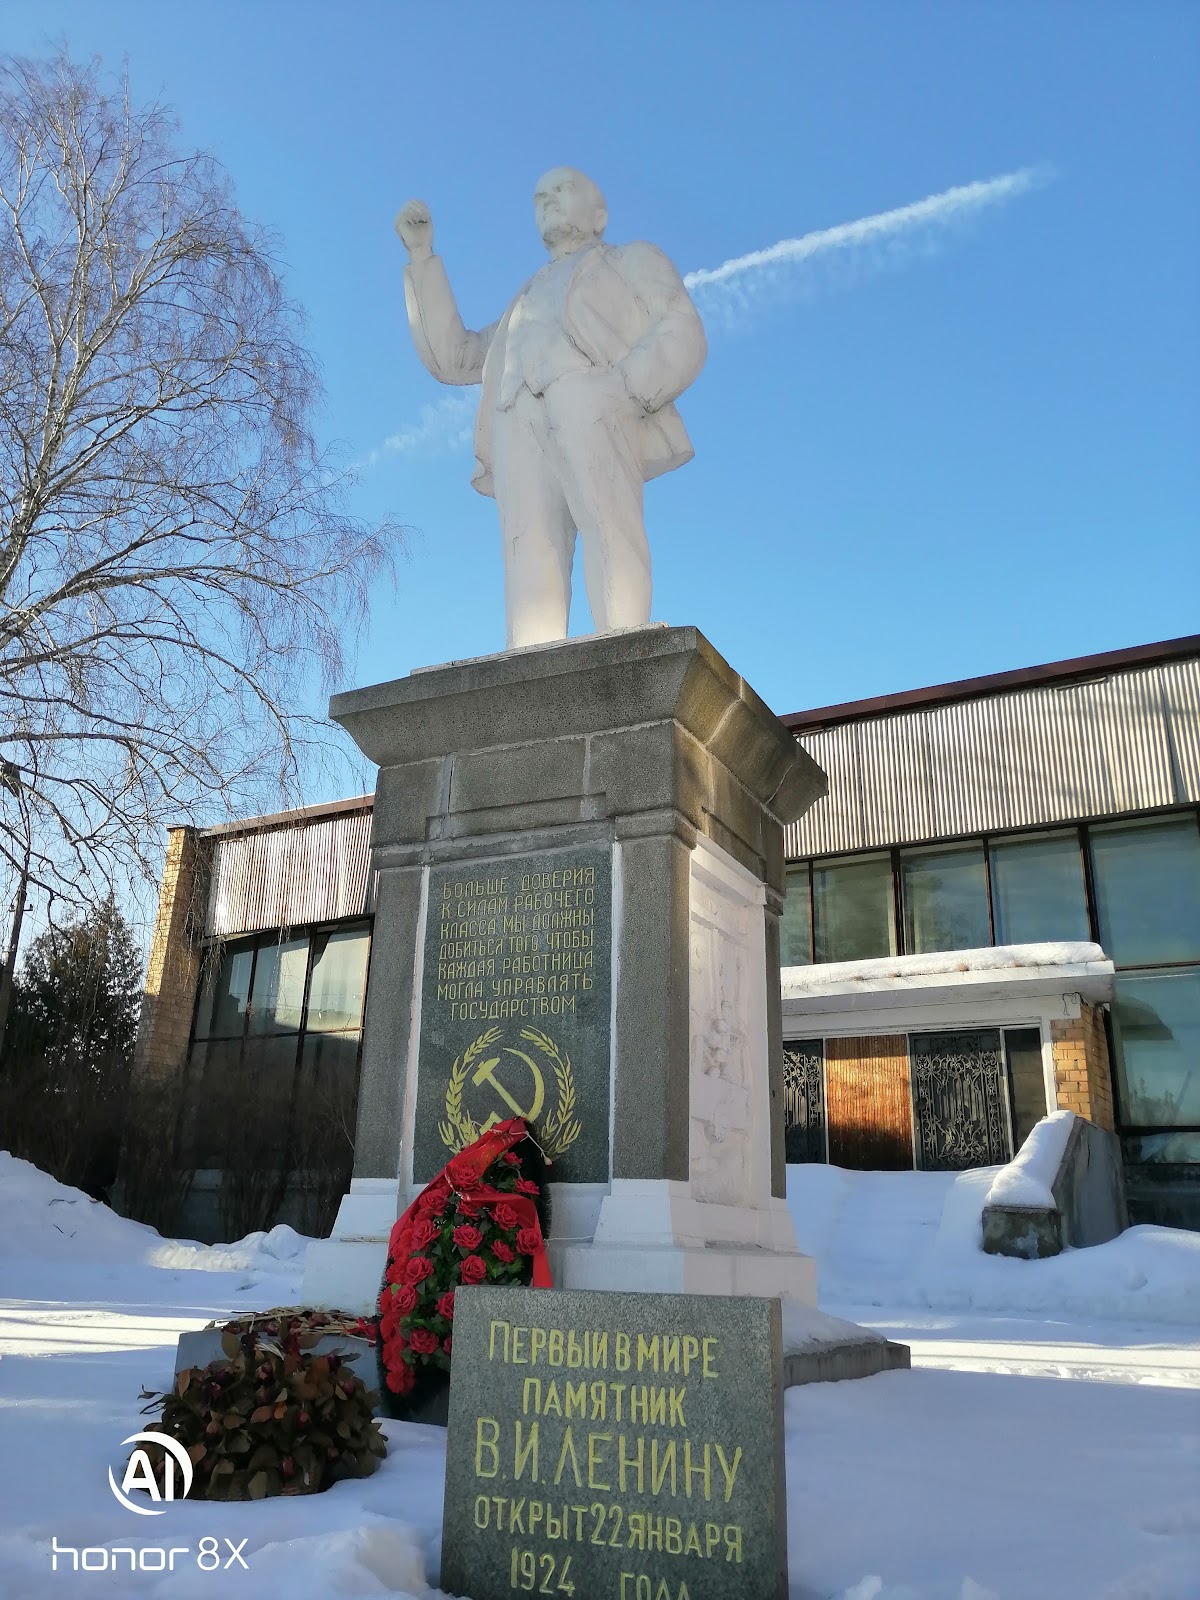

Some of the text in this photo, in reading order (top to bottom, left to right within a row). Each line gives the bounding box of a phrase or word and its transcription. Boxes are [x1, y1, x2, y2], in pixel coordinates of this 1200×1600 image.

[443, 867, 594, 900] БОЛЬШЕ ДОВЕРИЯ
[441, 888, 594, 919] К СИЛАМ РАБОЧЕГО
[441, 908, 594, 939] КЛАССА МЫ ДОЛЖНЫ
[439, 929, 594, 960] ДОБИТЬСЯ ТОГО ЧТОБЫ
[438, 951, 593, 980] КАЖДАЯ РАБОТНИЦА
[438, 972, 593, 1001] МОГЛА УПРАВЛЯТЬ
[451, 995, 575, 1021] ГОСУДАРСТВОМ
[615, 1331, 631, 1371] В
[636, 1333, 720, 1378] МИРЕ
[523, 1377, 687, 1427] ПАМЯТНИК
[554, 1425, 743, 1503] ЛЕНИНУ
[474, 1495, 743, 1563] ОТКРЫТ 22 ЯНВАРЯ
[510, 1547, 576, 1596] 1924
